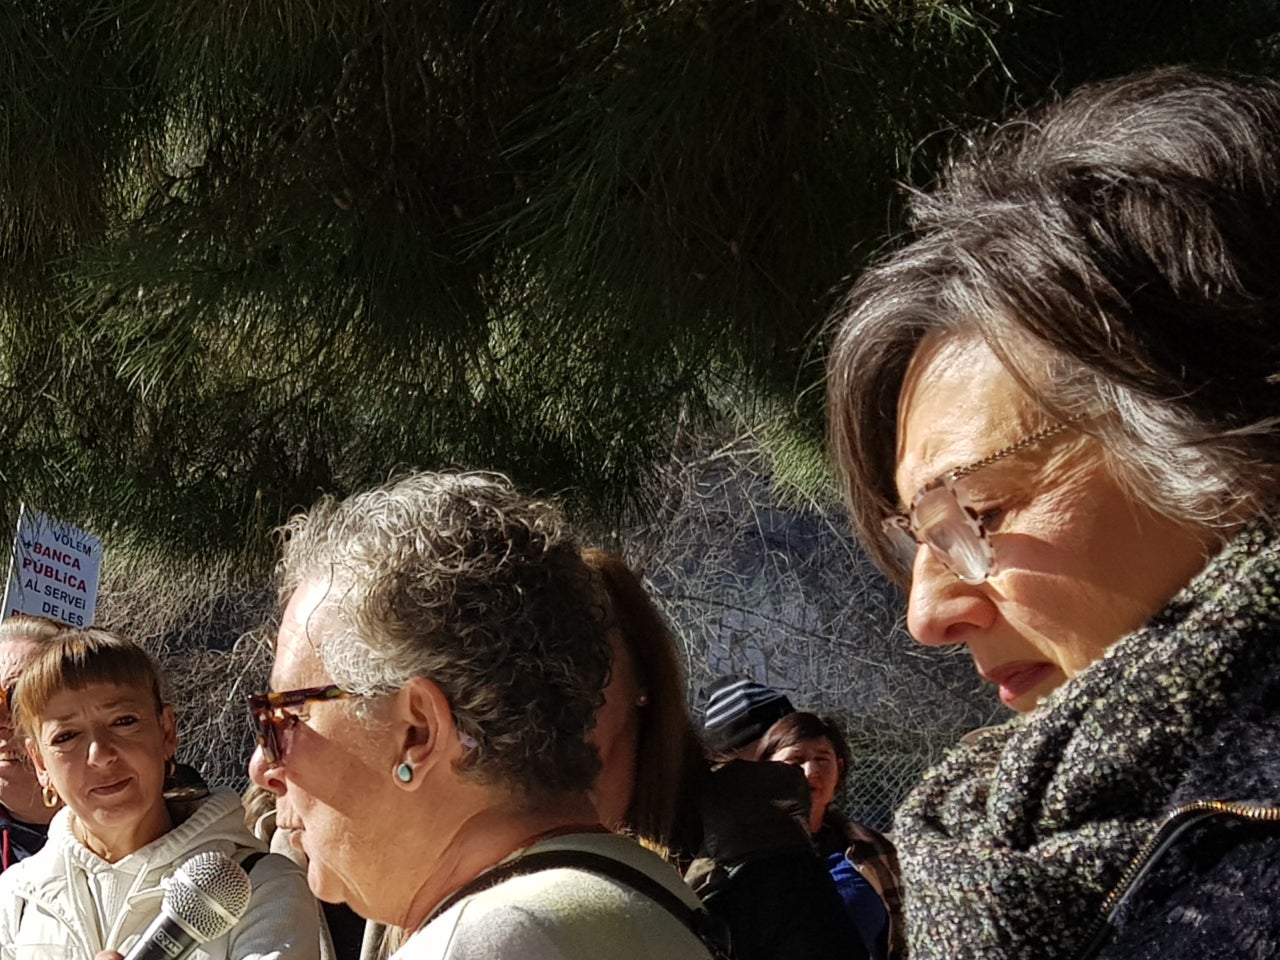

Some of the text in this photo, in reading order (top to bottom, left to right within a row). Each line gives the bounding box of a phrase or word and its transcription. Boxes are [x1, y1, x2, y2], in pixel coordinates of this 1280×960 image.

[53, 530, 92, 556] VOLEM
[24, 578, 41, 593] AL
[42, 602, 59, 617] DE
[61, 609, 84, 627] LES
